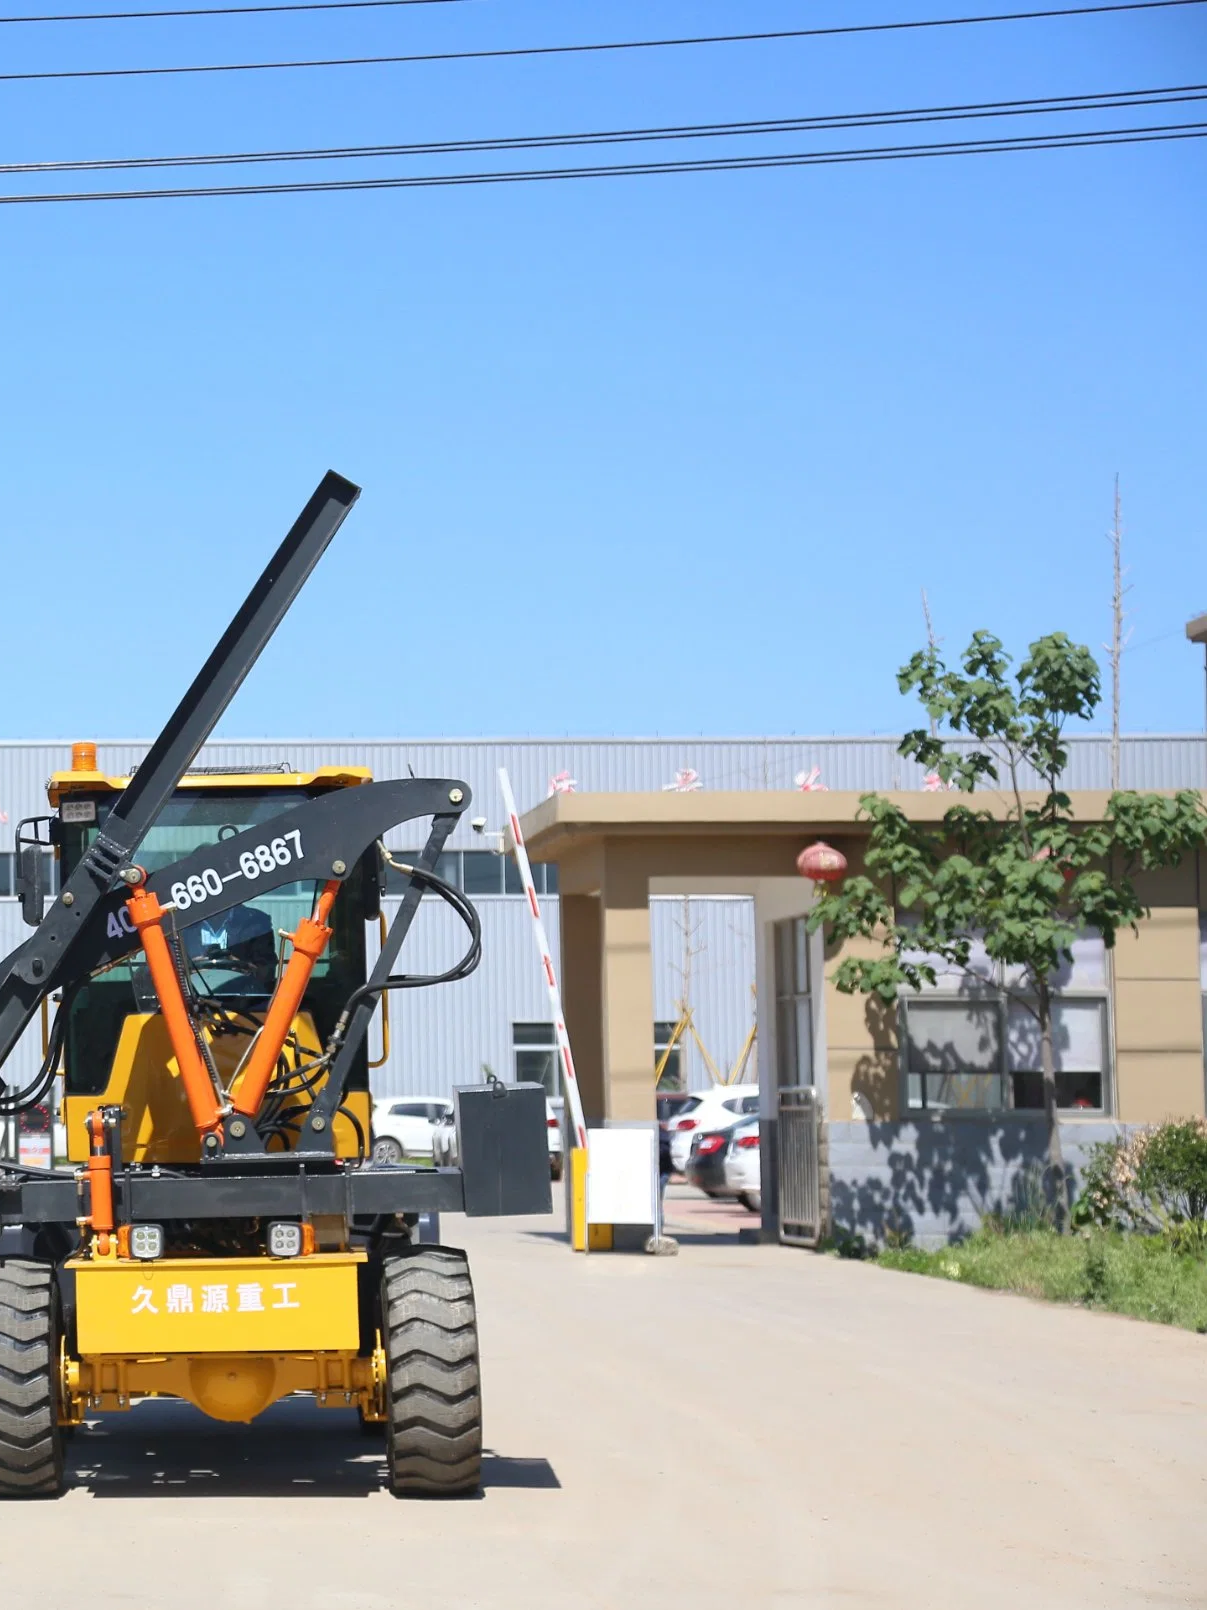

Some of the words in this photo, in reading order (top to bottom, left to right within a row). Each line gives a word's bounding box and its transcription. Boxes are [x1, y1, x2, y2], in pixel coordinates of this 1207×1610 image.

[131, 1282, 301, 1315] 久鼎源重工
